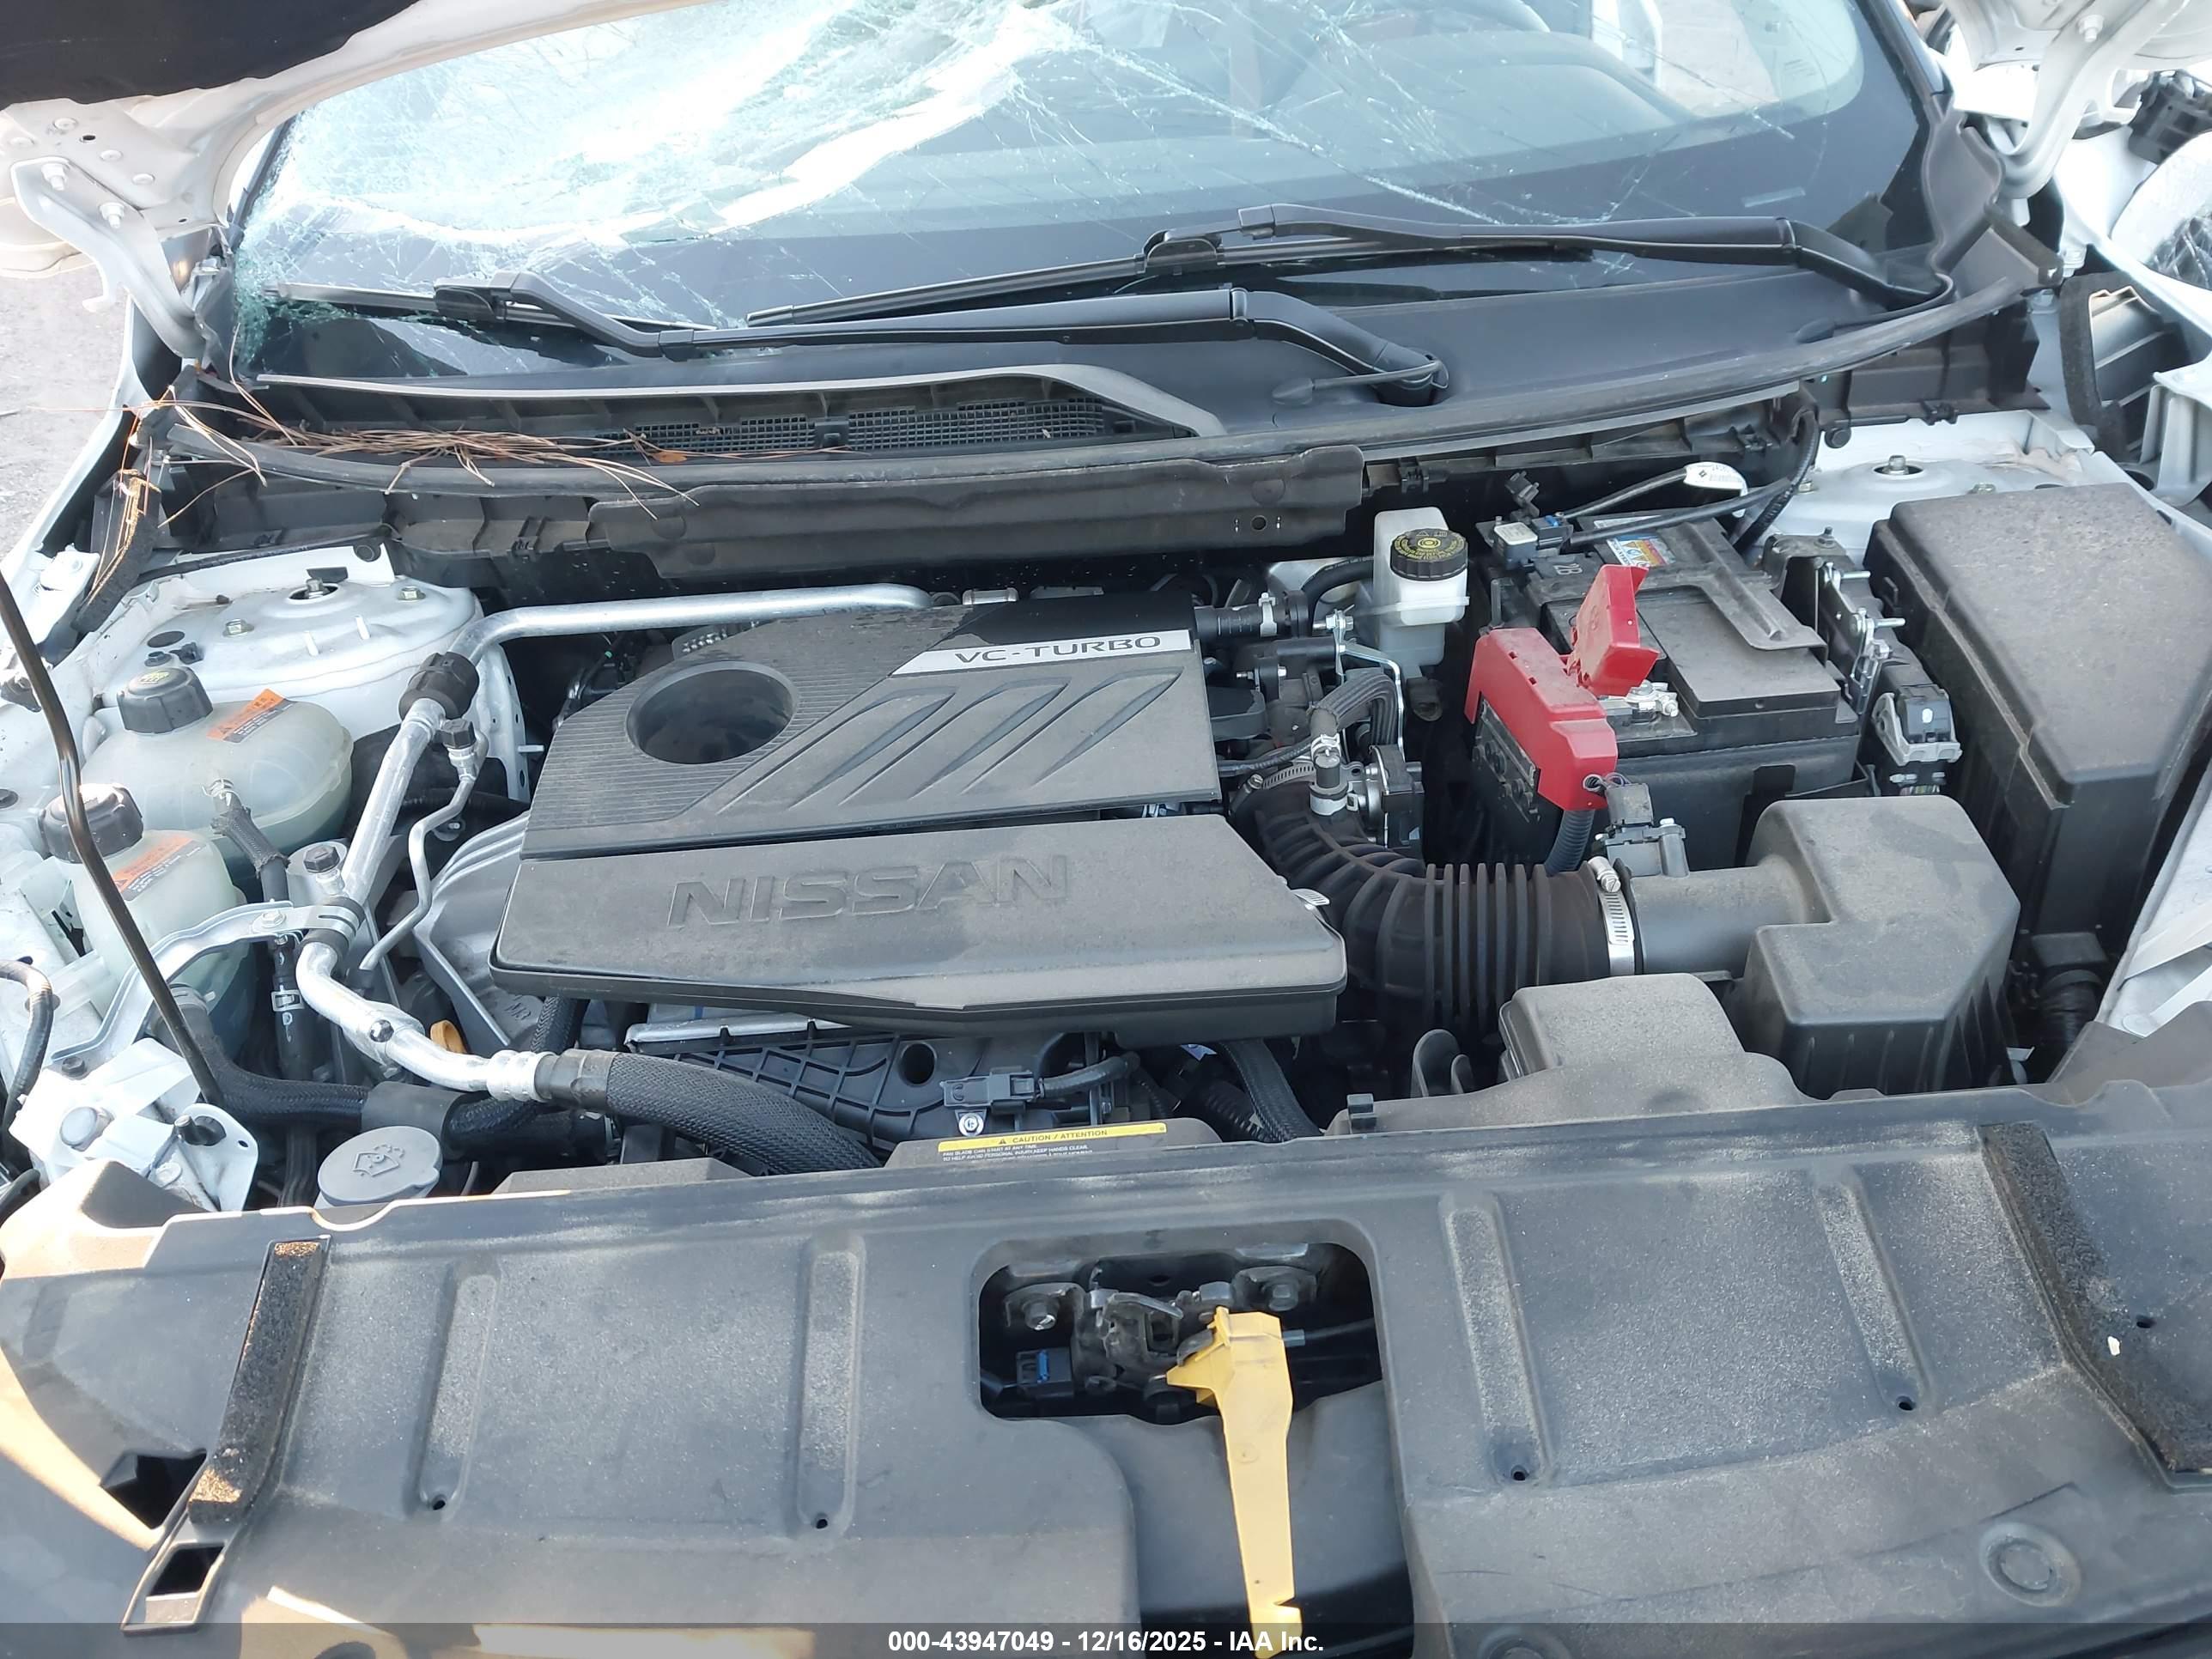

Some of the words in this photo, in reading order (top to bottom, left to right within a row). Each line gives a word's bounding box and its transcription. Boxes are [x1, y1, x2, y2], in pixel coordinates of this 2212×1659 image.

[955, 635, 1161, 664] VC-TURBO
[667, 854, 1069, 927] NISSAN
[1012, 1133, 1050, 1144] CAUTION
[1060, 1129, 1108, 1139] ATTENTION
